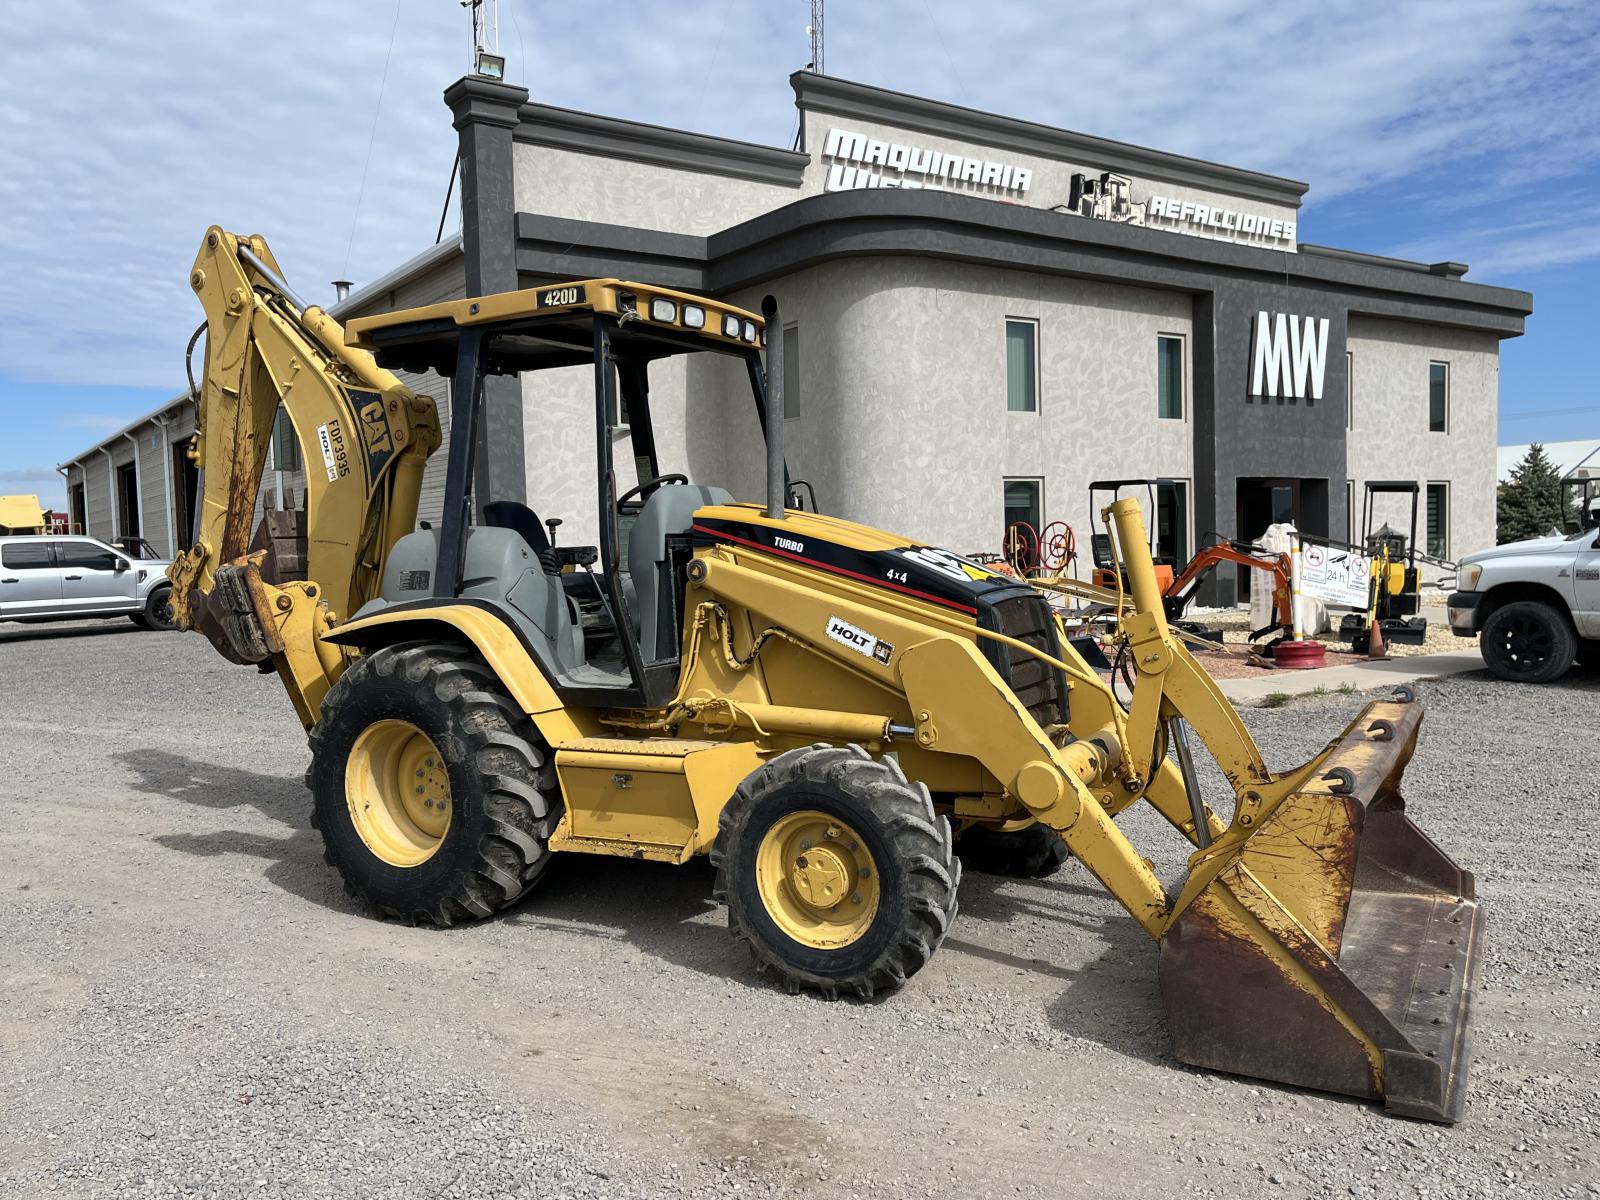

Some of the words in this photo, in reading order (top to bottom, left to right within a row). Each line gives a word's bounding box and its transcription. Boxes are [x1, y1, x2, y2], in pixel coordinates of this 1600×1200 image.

[823, 128, 1033, 191] MAQUINARIA
[1149, 196, 1297, 240] REFACCIONES
[545, 288, 578, 306] 420D
[1252, 310, 1330, 400] MW
[329, 419, 351, 478] FDP3935
[361, 401, 392, 455] CAT
[774, 536, 804, 553] TURBO
[1326, 569, 1337, 581] 24
[1339, 572, 1346, 583] h
[832, 624, 871, 647] HOLT
